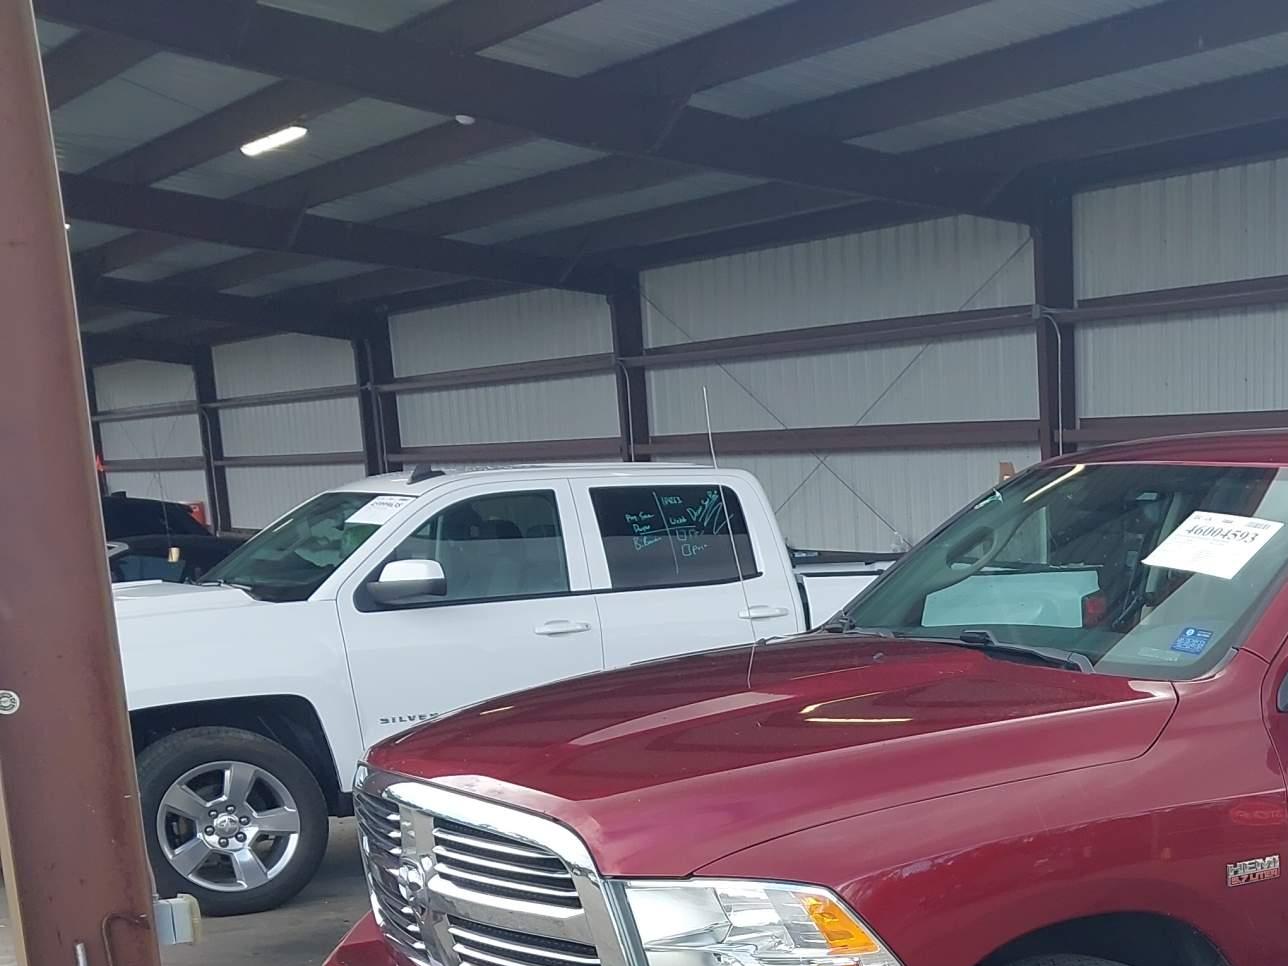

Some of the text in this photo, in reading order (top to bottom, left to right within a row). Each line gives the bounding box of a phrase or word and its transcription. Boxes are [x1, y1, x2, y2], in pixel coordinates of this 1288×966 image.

[1186, 524, 1259, 543] 46004593
[1227, 855, 1280, 877] HEMI
[1249, 867, 1280, 881] LITER
